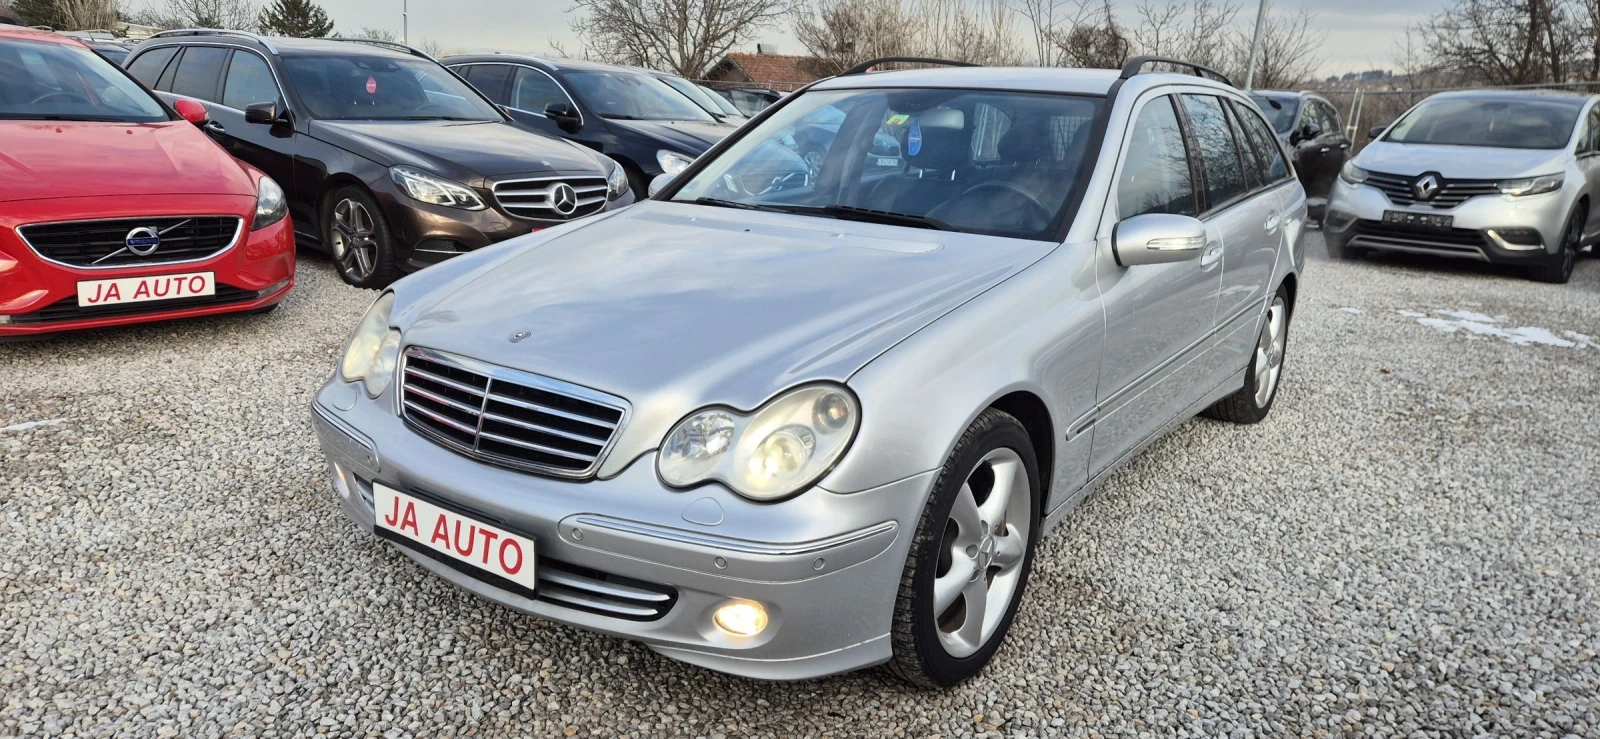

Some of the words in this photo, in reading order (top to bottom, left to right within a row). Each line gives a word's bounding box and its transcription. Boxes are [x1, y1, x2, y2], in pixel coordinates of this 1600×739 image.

[87, 282, 121, 303] JA
[133, 276, 206, 299] AUTO
[384, 496, 419, 537] JA
[430, 513, 523, 575] AUTO
